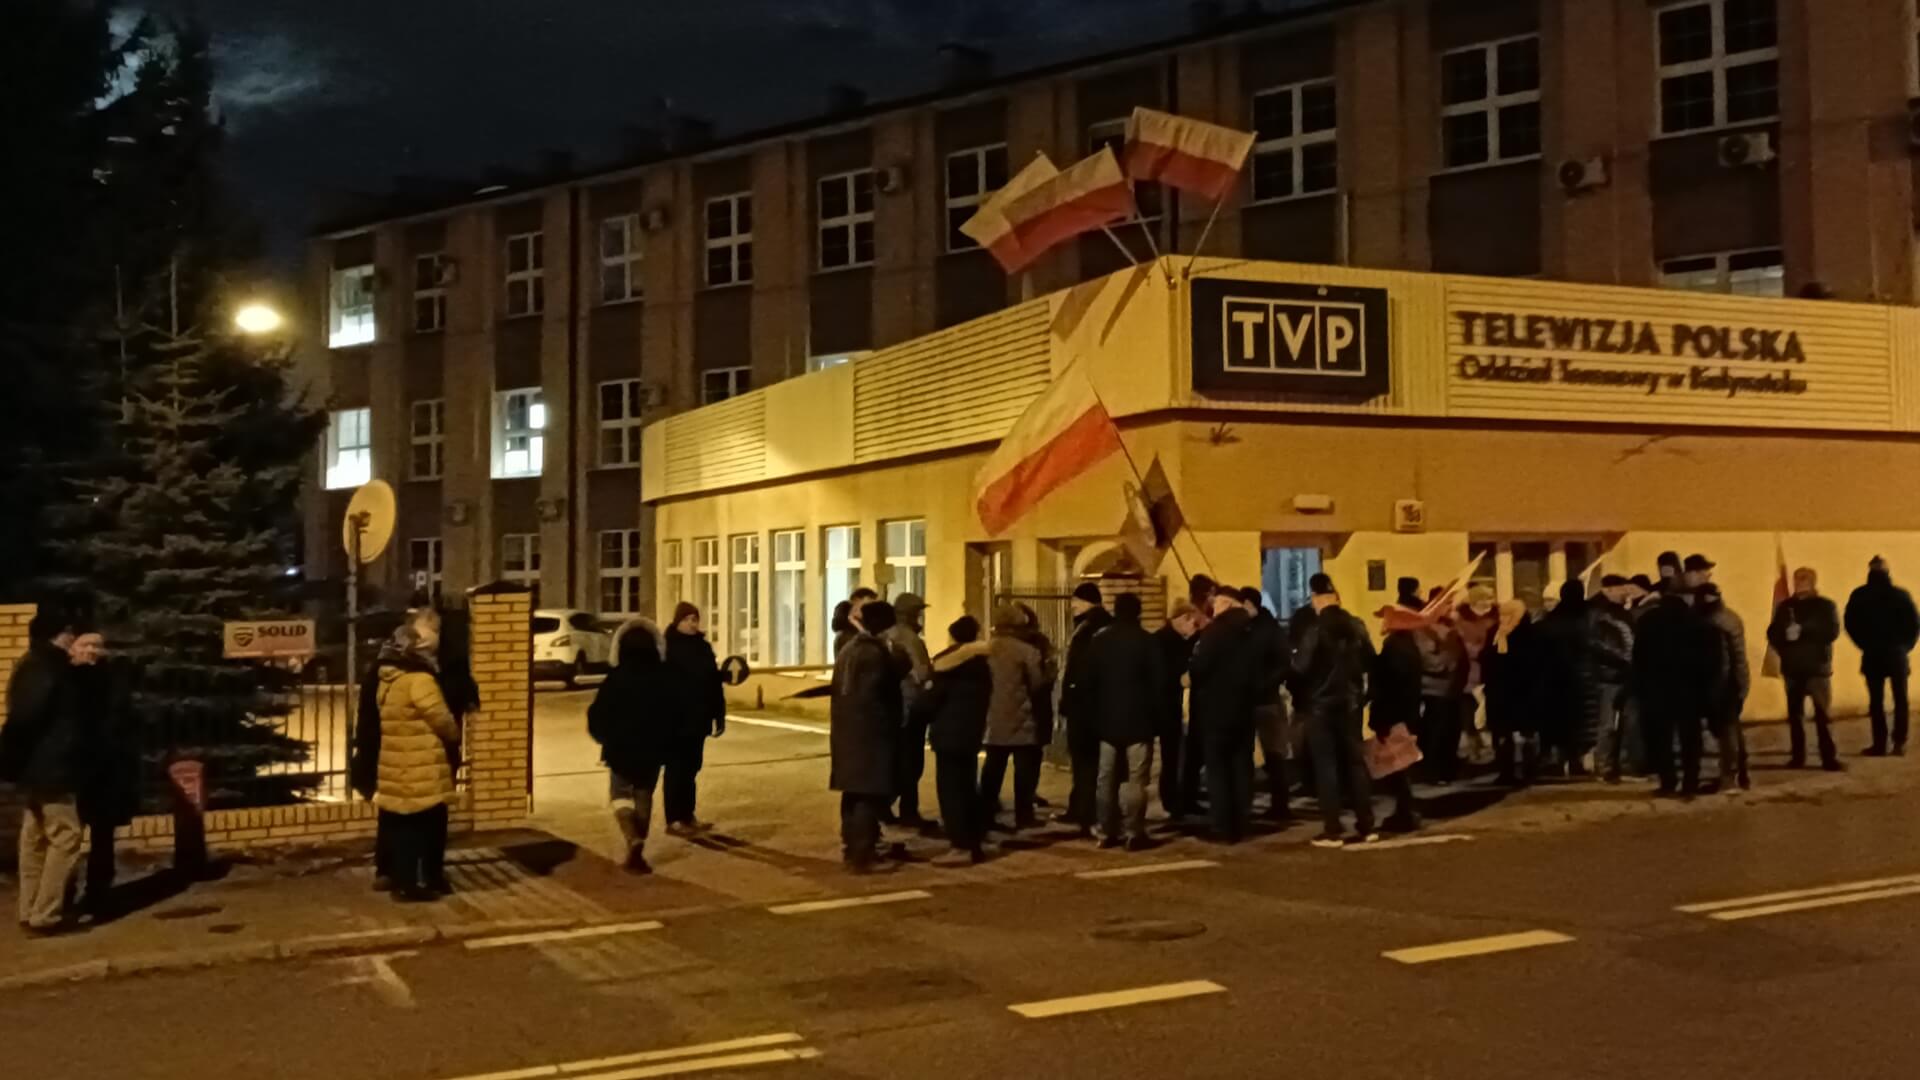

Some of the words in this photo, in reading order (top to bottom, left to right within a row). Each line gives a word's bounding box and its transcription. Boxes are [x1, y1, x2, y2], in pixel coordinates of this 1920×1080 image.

[1231, 310, 1354, 363] TVP
[1455, 311, 1661, 355] TELEWIZJA
[1672, 323, 1806, 364] POLSKA
[257, 624, 308, 638] SOLID
